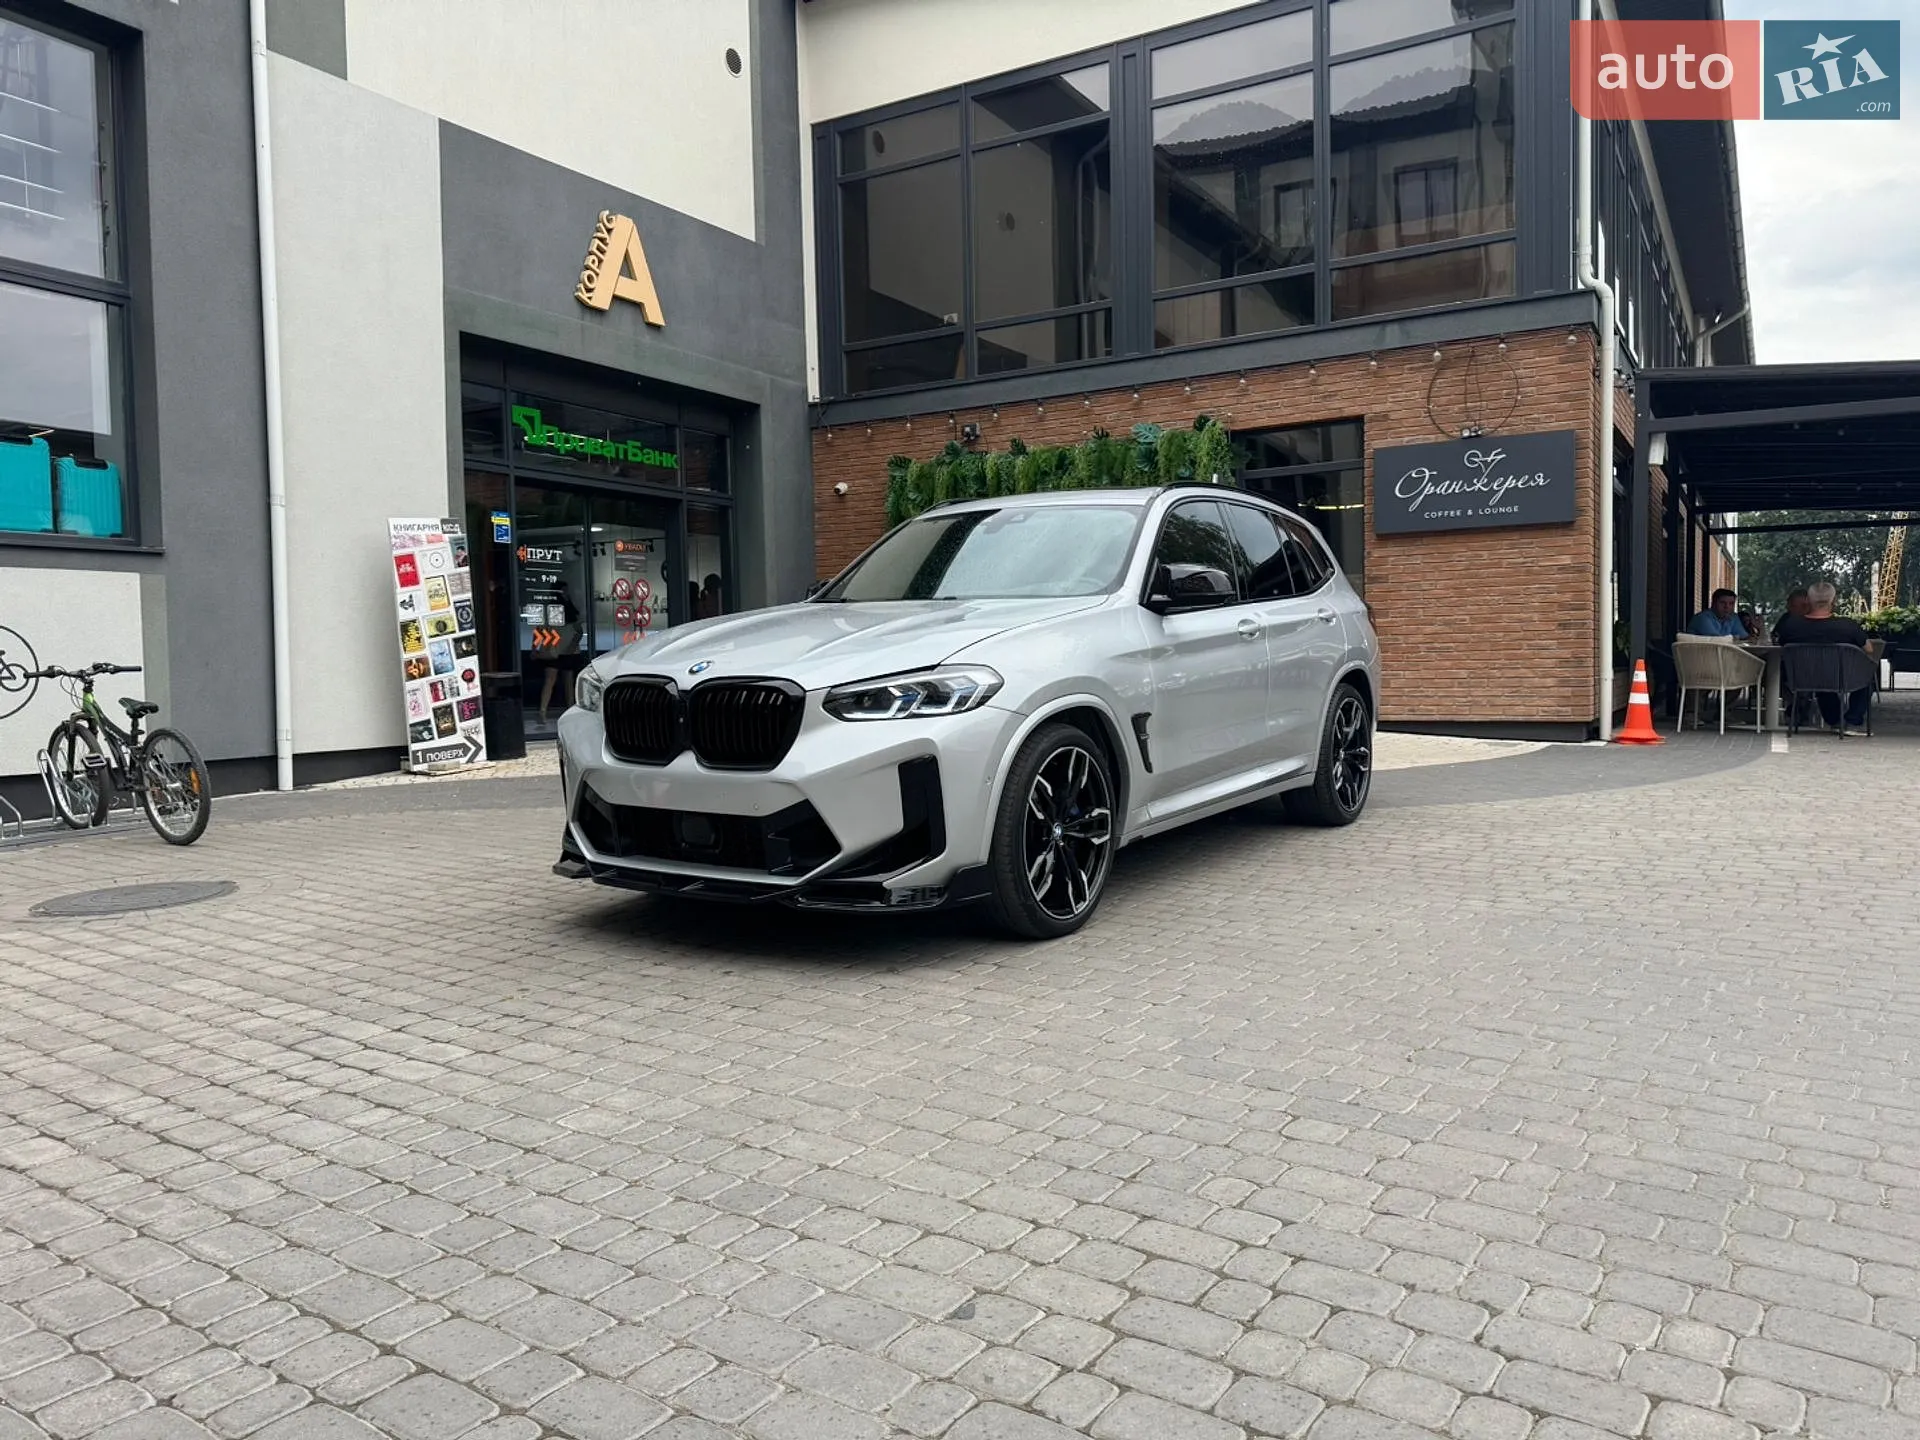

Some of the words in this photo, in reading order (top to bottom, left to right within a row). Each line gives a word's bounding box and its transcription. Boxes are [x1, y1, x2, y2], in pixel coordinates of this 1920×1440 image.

[574, 210, 616, 306] КОРПУС
[541, 425, 680, 469] ПриватБанк
[1395, 456, 1551, 512] Оранжерея
[1424, 509, 1461, 519] COFFEE
[1466, 508, 1474, 516] &
[1478, 505, 1519, 515] LOUNGE
[393, 523, 440, 533] КНИГАРНЯ
[526, 547, 563, 561] ПРУТ
[416, 751, 423, 763] 1
[426, 748, 464, 762] ПОВЕРХ
